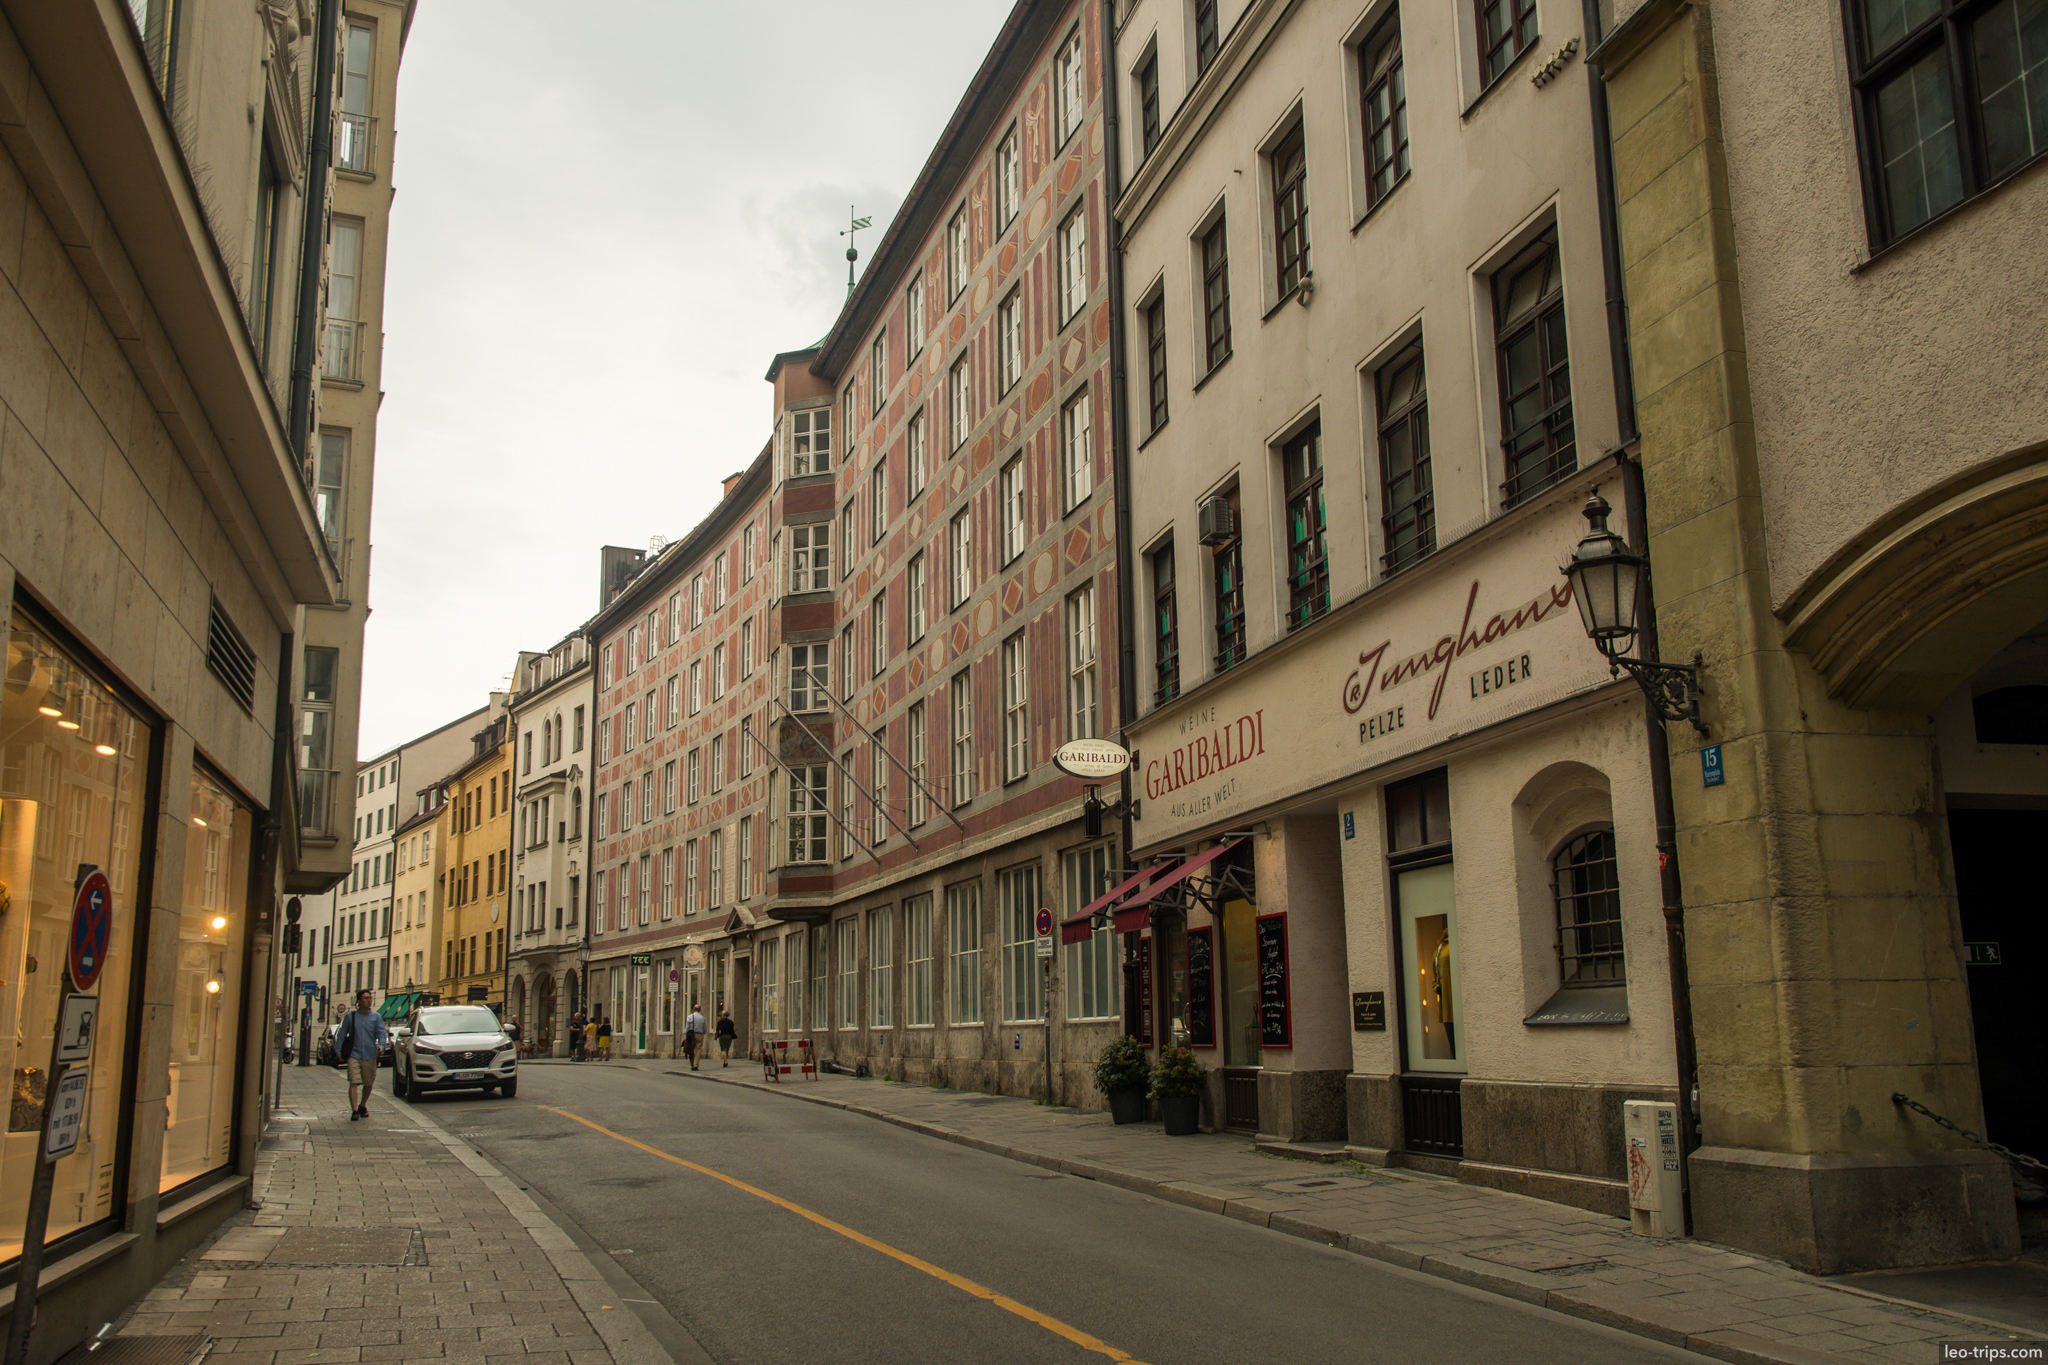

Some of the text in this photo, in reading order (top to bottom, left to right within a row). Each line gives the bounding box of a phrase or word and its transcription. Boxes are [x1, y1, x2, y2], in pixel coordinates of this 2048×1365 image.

[1343, 581, 1573, 720] Junghans
[1470, 654, 1531, 699] LEDER
[1179, 707, 1215, 735] WEINE
[1360, 706, 1404, 743] PELZE
[1059, 751, 1127, 763] GARIBALDI
[1146, 708, 1265, 800] GARIBALDI
[1705, 748, 1717, 767] 15
[1171, 778, 1235, 818] AUS ALLER WELT
[1346, 814, 1351, 827] 2
[632, 956, 650, 964] TEE
